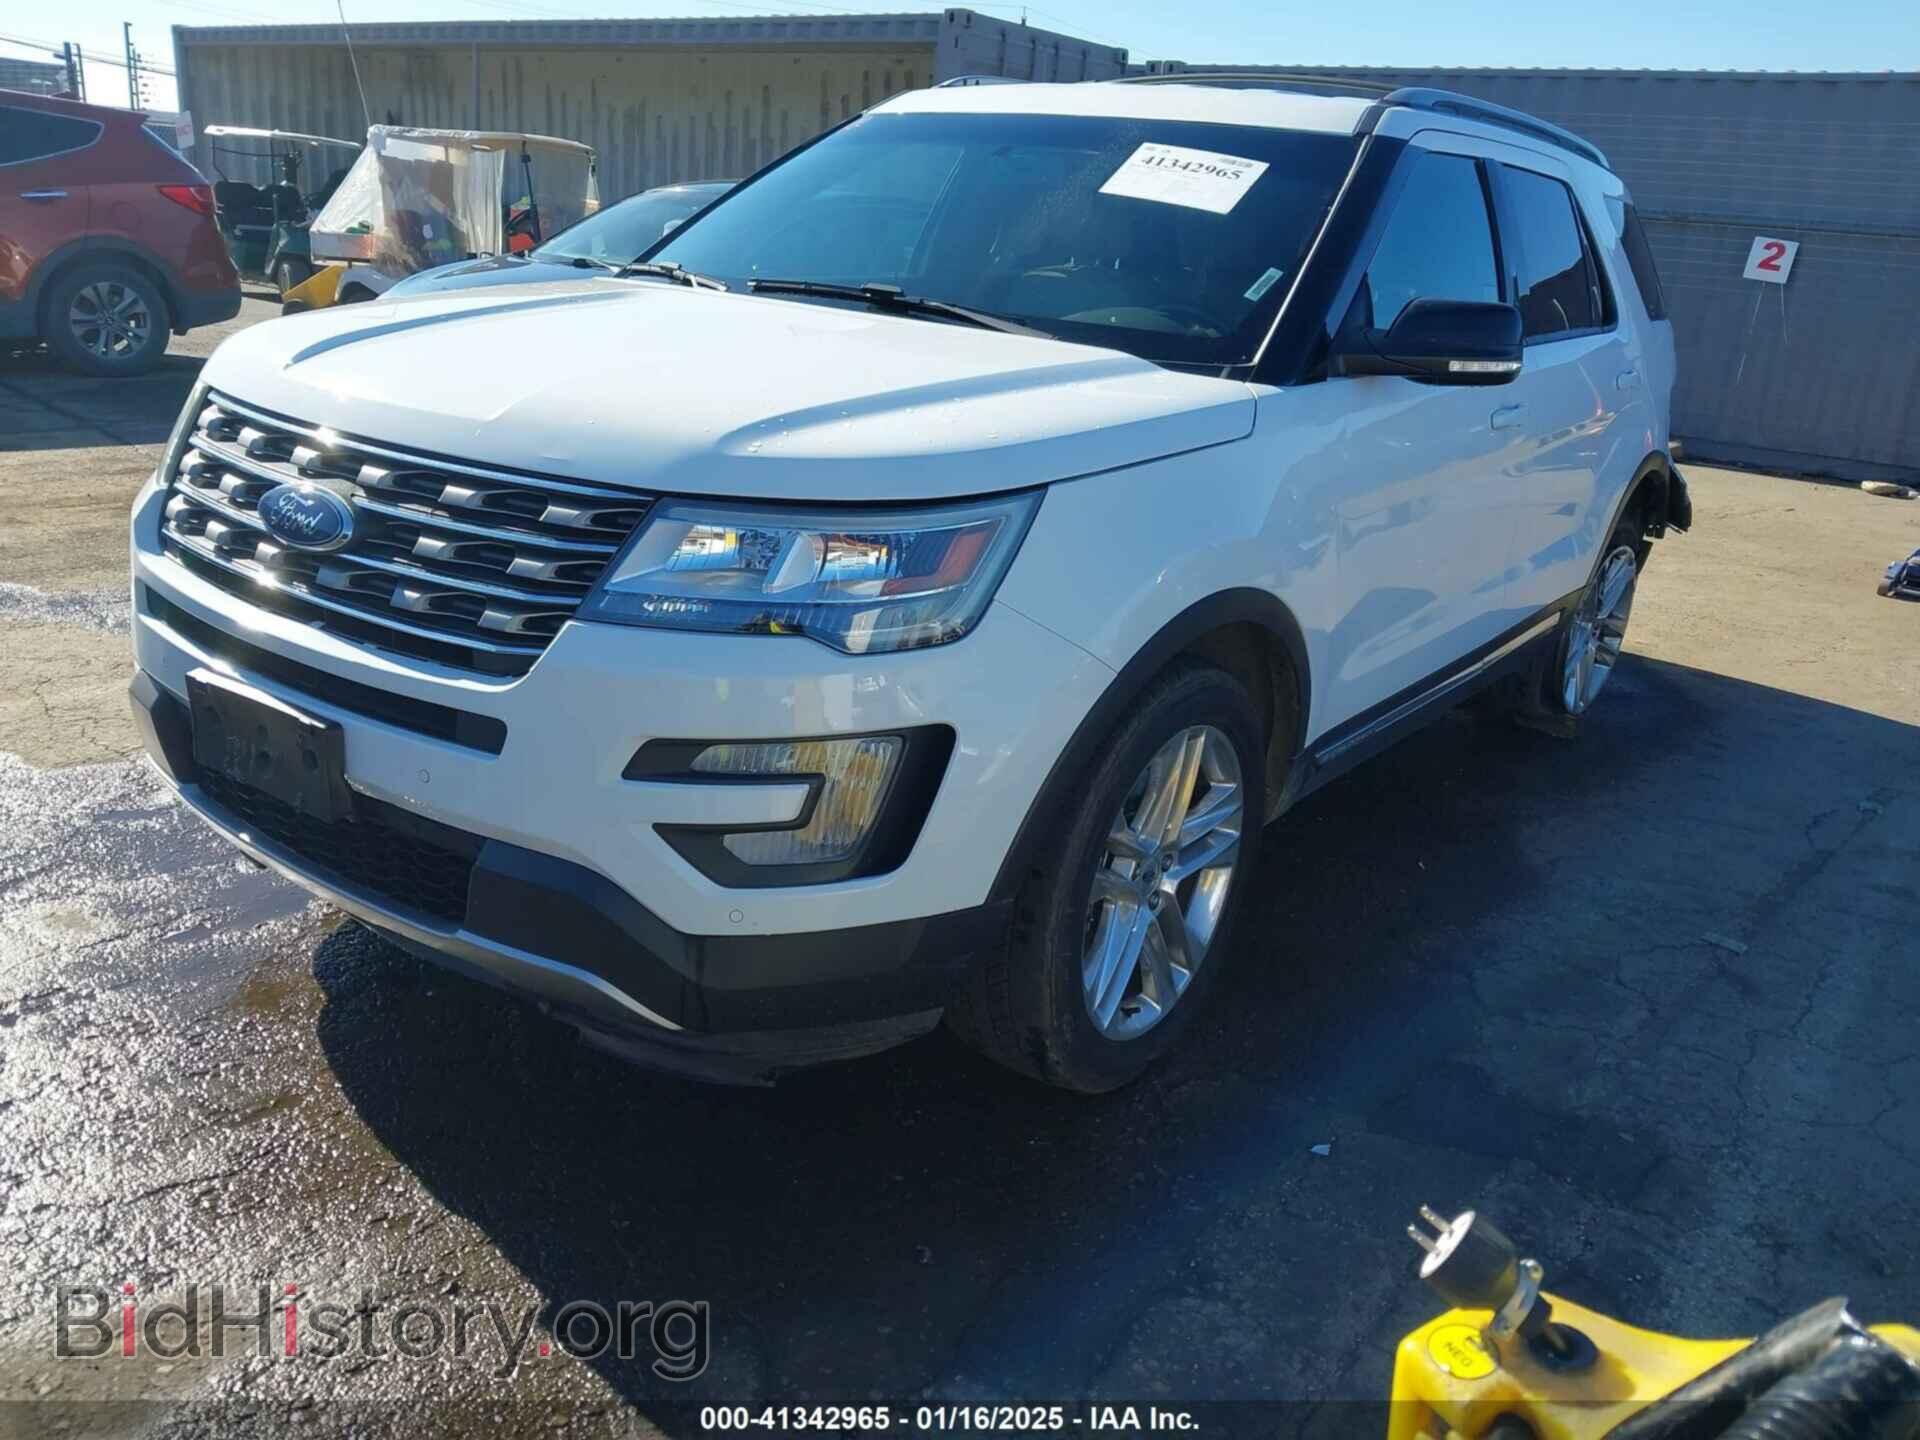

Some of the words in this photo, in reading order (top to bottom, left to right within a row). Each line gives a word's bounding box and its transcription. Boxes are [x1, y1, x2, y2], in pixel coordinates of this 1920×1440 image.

[1141, 155, 1243, 181] 41342965
[1757, 240, 1786, 272] 2
[275, 492, 325, 531] Ford
